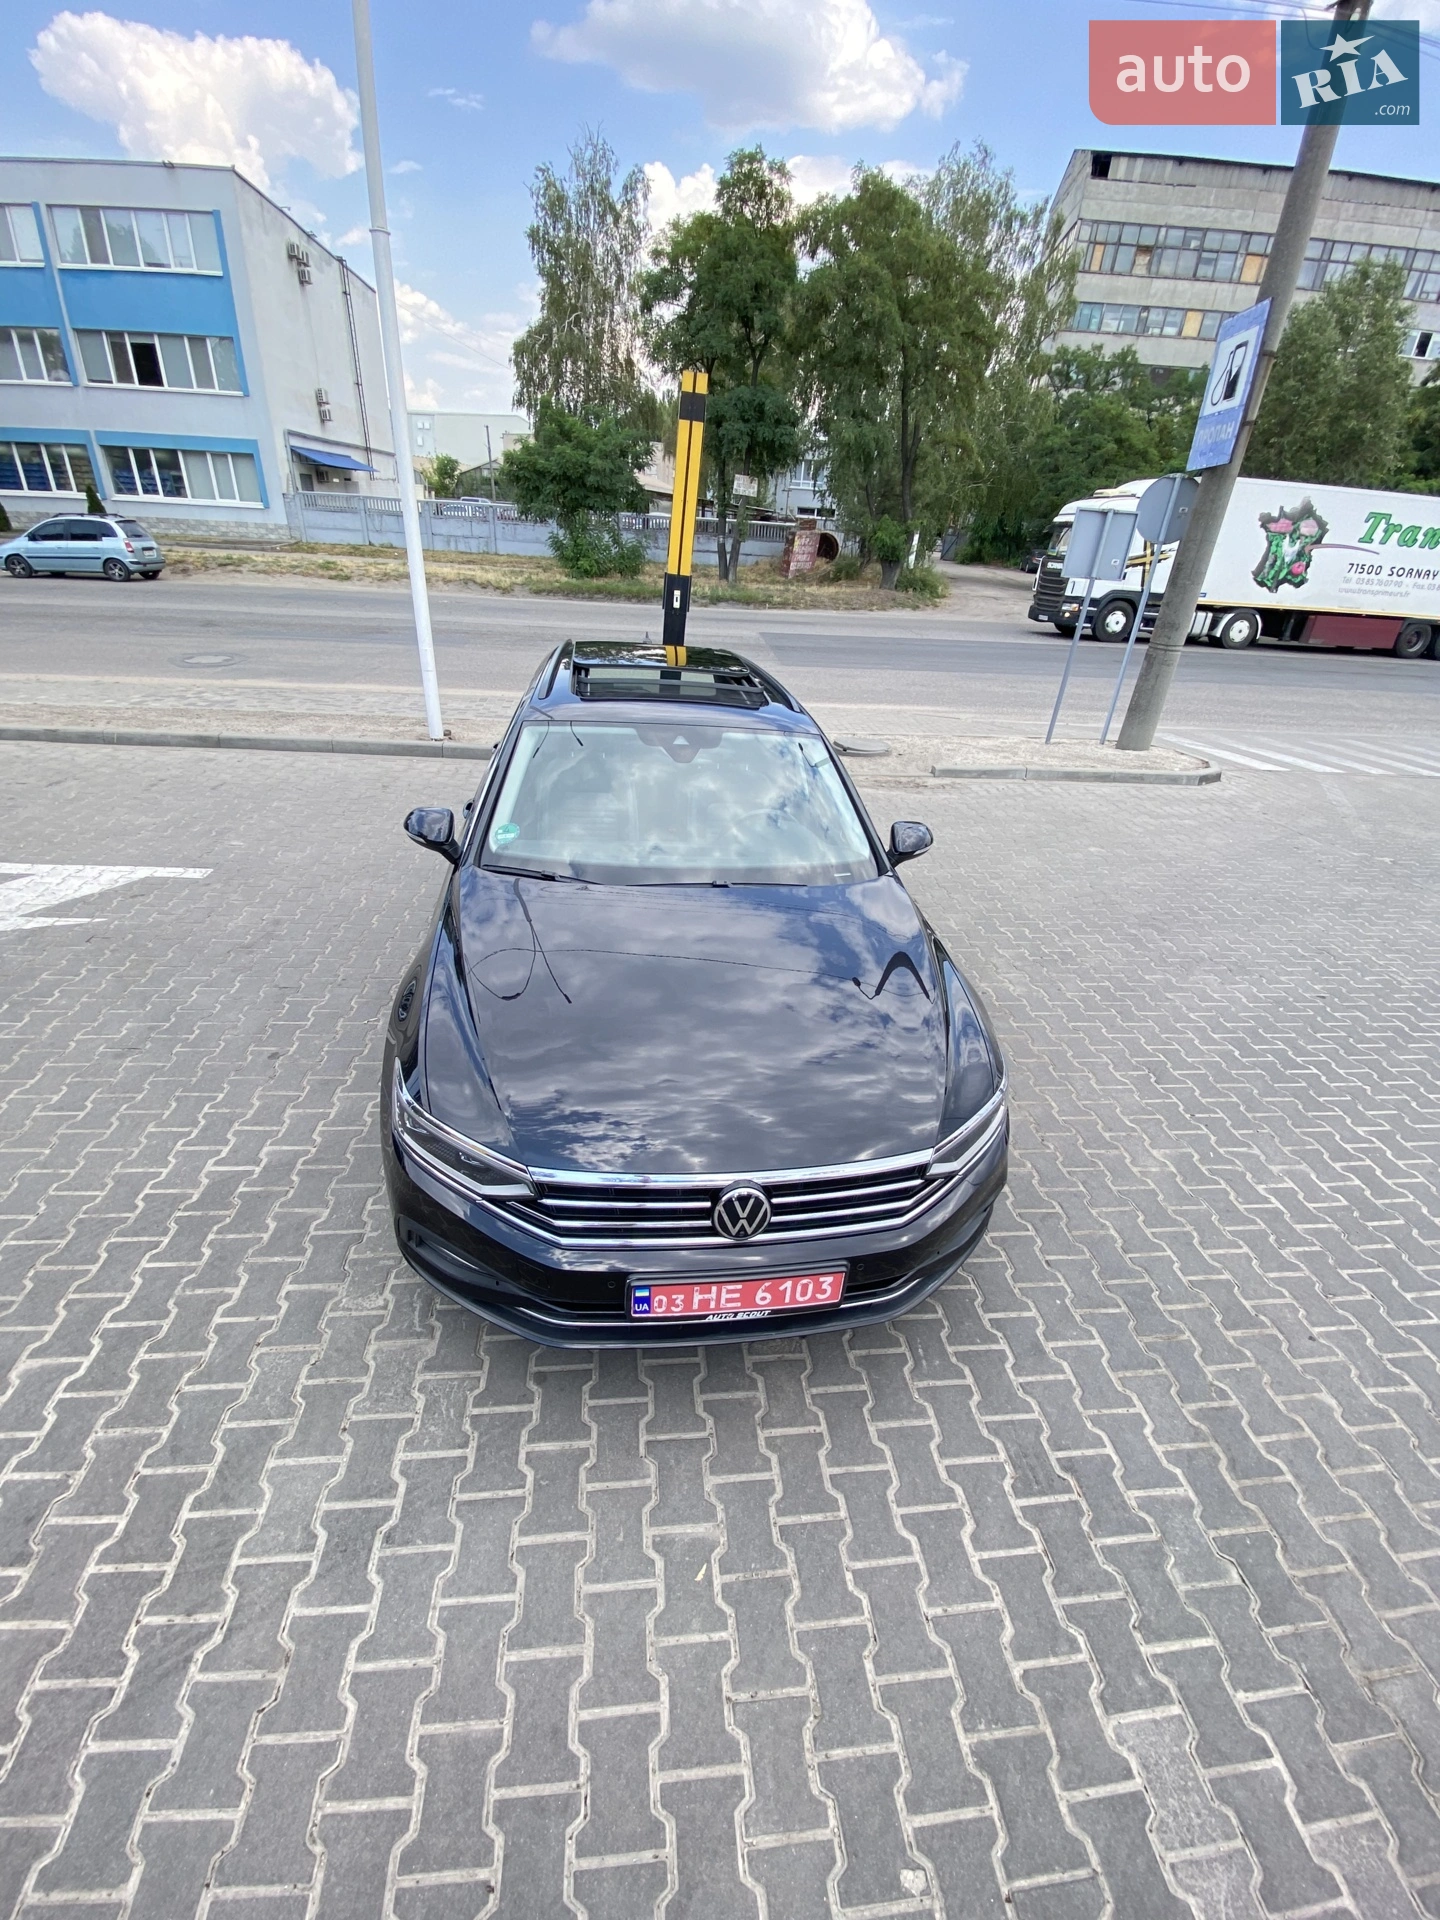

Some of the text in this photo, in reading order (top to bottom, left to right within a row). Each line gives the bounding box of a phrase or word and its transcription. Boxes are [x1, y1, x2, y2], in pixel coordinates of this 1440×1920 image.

[1196, 420, 1235, 447] ПРОПАН
[1358, 511, 1440, 550] Tran
[1347, 562, 1440, 580] 71500 SORNAY
[634, 1276, 834, 1313] UA 03 HE 6103
[706, 1310, 771, 1321] AUTO SCOUT
